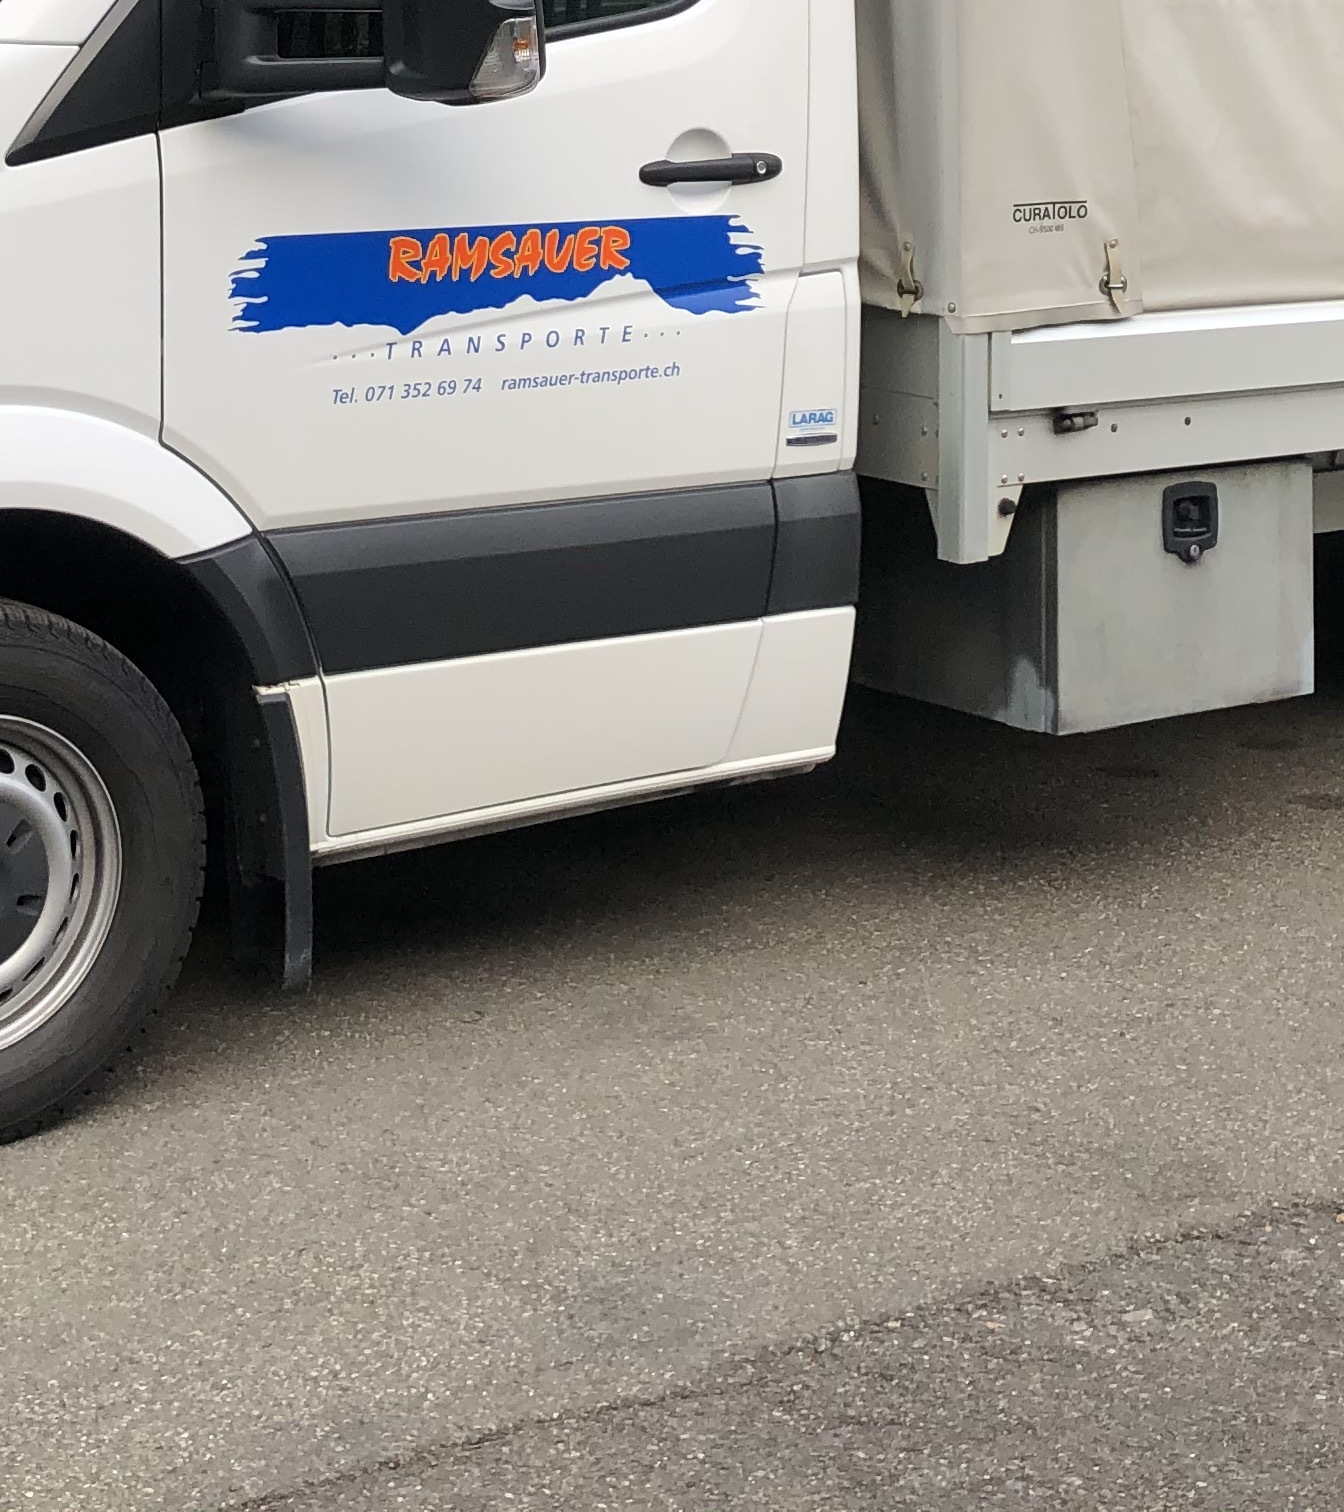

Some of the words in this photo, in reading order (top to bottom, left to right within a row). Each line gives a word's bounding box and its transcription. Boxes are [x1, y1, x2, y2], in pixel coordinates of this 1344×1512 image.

[1012, 200, 1088, 223] CURATOLO
[388, 226, 631, 284] RAMSAUER
[332, 387, 359, 405] Tel.
[365, 384, 395, 403] 071
[400, 381, 432, 400] 352
[437, 379, 457, 396] 69
[462, 377, 483, 394] 74
[500, 361, 681, 391] ramsauer-transporte.ch
[792, 411, 834, 426] LARAG
